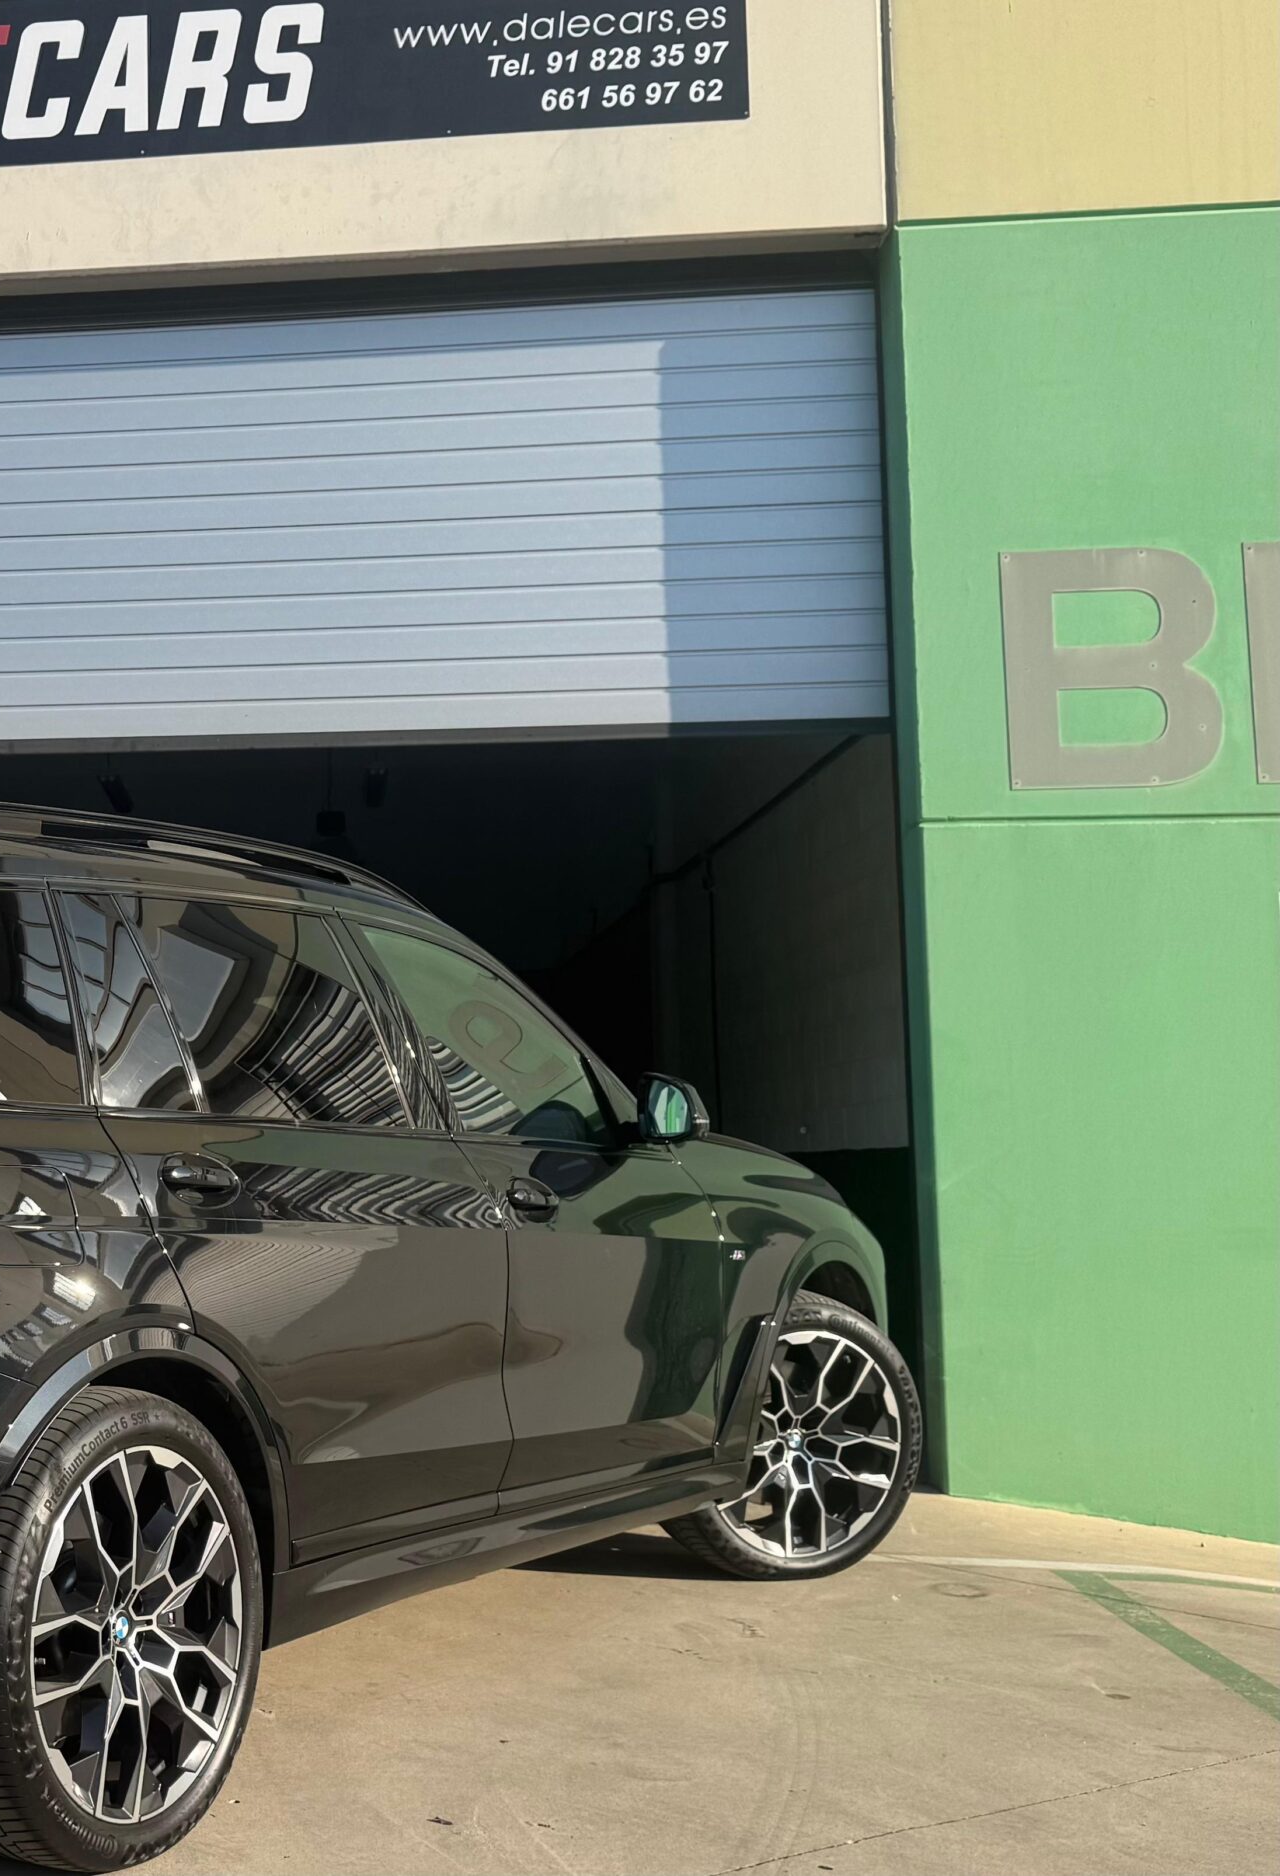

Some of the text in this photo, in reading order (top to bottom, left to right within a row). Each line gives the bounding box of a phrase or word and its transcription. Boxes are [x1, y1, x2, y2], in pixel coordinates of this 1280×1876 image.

[393, 5, 727, 49] www.dalecars.es
[487, 40, 729, 78] Tel. 91 828 35 97
[540, 78, 724, 112] 661 56 97 62
[998, 541, 1280, 790] B
